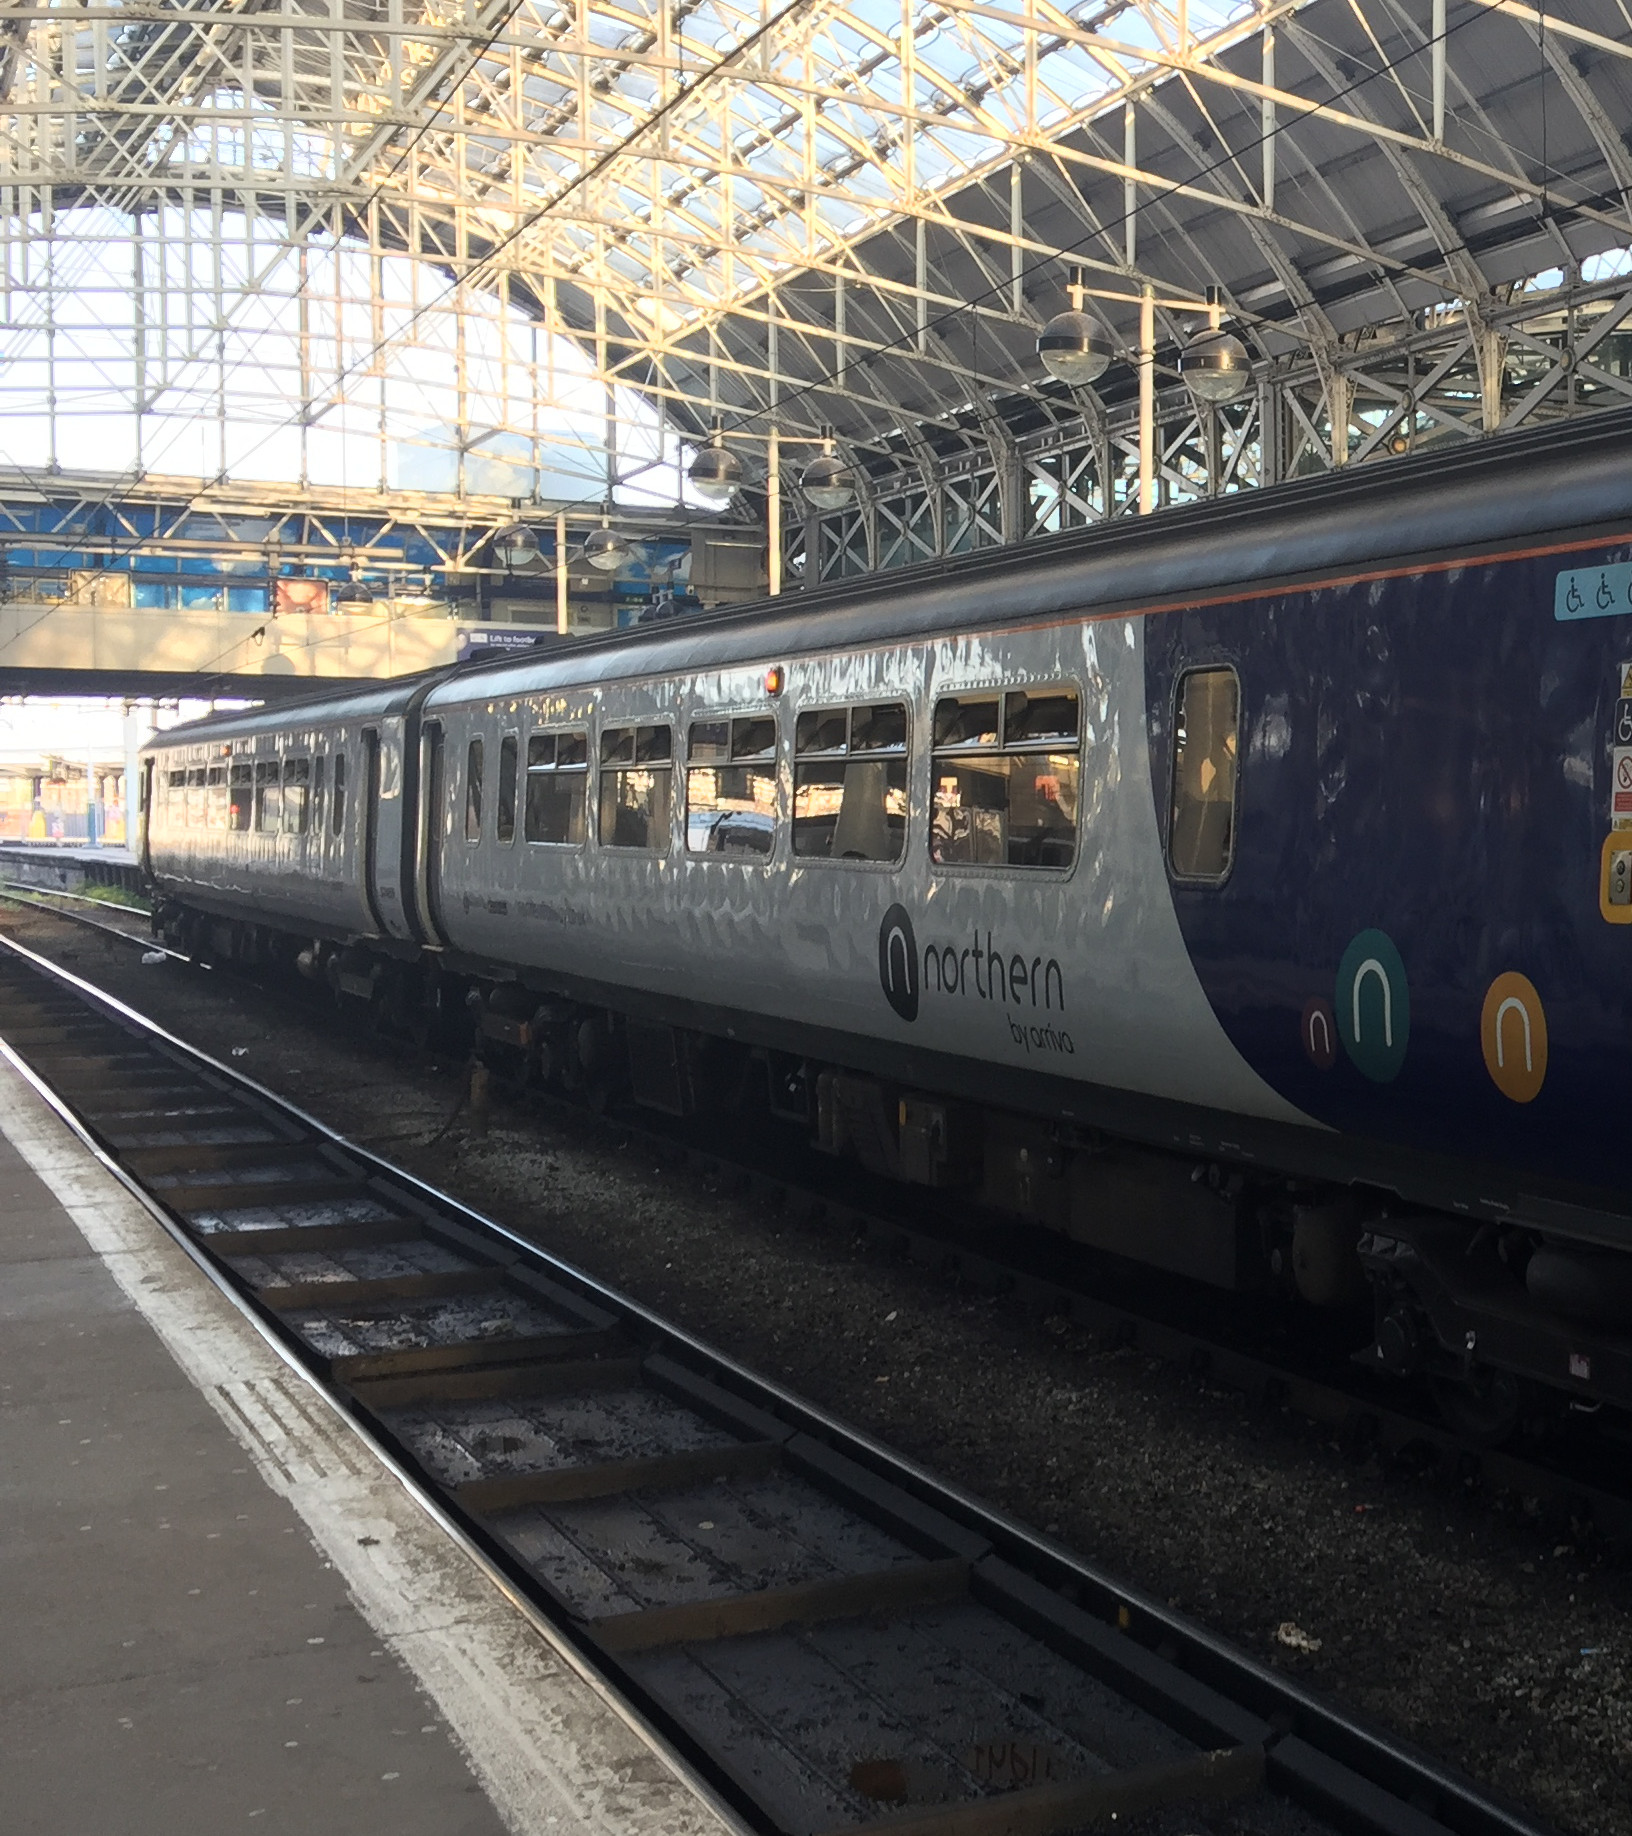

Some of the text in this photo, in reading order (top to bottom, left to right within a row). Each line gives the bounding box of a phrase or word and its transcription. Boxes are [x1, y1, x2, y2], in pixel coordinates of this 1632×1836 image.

[489, 634, 502, 643] Lift
[923, 929, 1066, 1012] northern
[1006, 1012, 1076, 1055] by arriva
